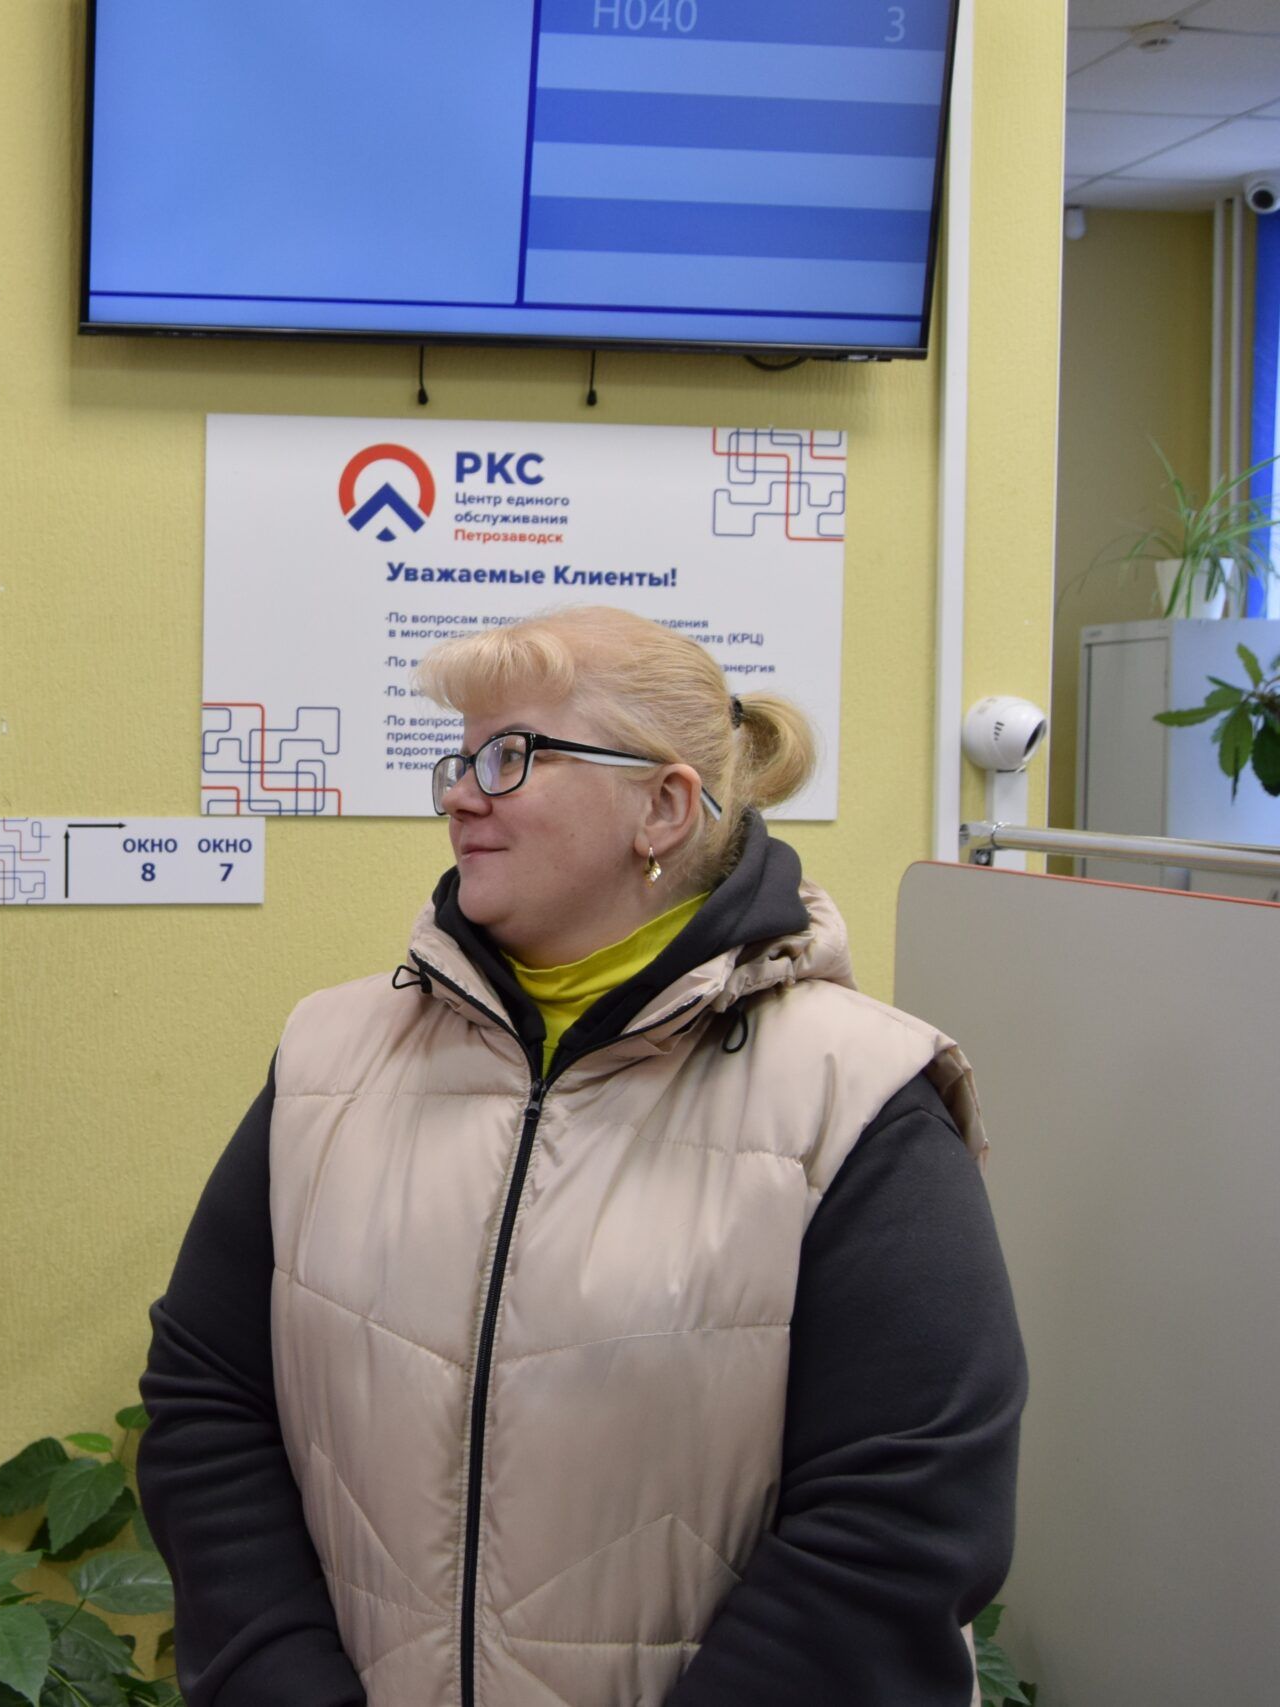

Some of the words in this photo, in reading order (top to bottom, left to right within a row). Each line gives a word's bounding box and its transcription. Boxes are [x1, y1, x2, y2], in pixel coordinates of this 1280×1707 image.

[884, 6, 906, 43] 3
[455, 452, 545, 485] РКС
[455, 492, 502, 506] Центр
[506, 495, 570, 507] единого
[454, 511, 568, 526] обслуживания
[454, 529, 564, 544] Петрозаводск
[386, 562, 546, 585] Уважаемые
[553, 565, 677, 588] Клиенты!
[411, 614, 478, 626] вопросам
[482, 615, 528, 627] водо
[388, 629, 396, 638] в
[727, 632, 764, 646] (КРЦ)
[721, 664, 776, 676] энергия
[386, 762, 394, 770] и
[140, 862, 156, 882] 8
[219, 862, 234, 882] 7
